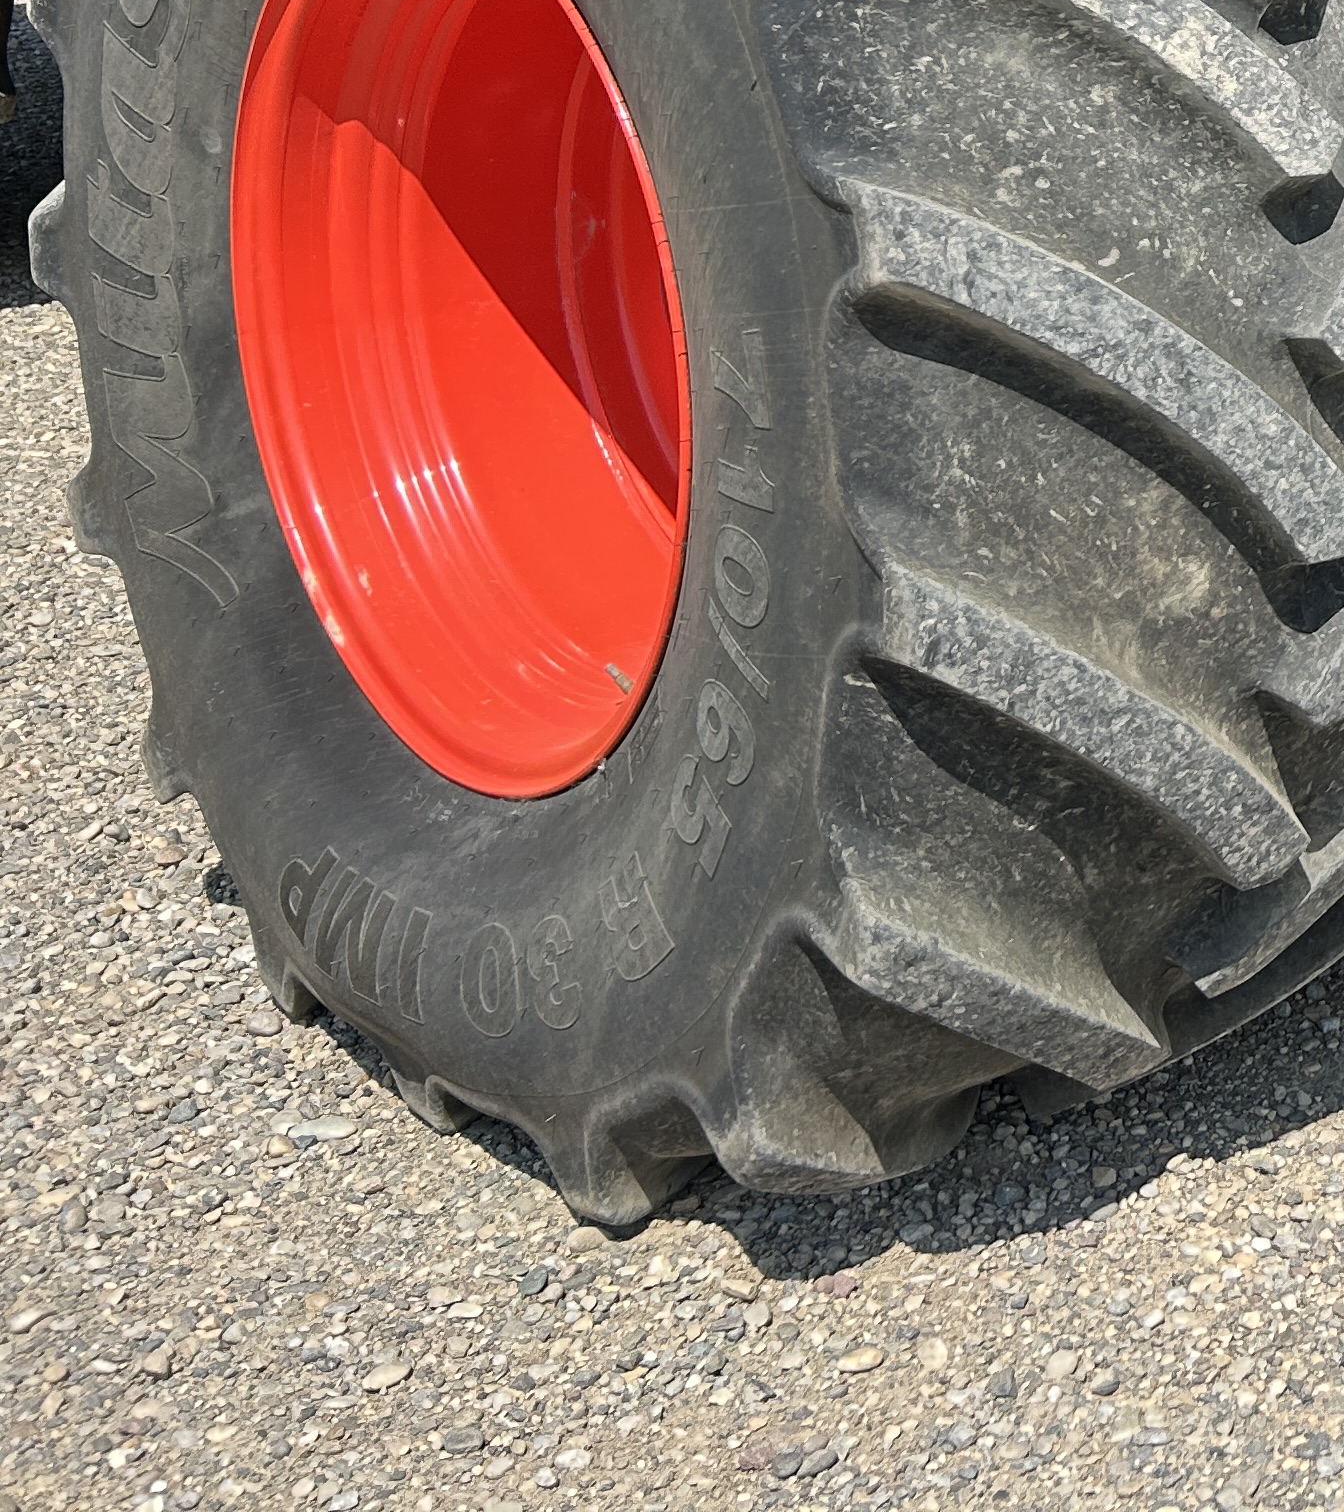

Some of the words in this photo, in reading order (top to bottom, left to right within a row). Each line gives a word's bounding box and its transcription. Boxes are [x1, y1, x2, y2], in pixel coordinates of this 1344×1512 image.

[670, 329, 775, 879] 710/65
[278, 846, 433, 1025] IMP
[460, 915, 583, 1038] 30
[603, 851, 675, 982] R
